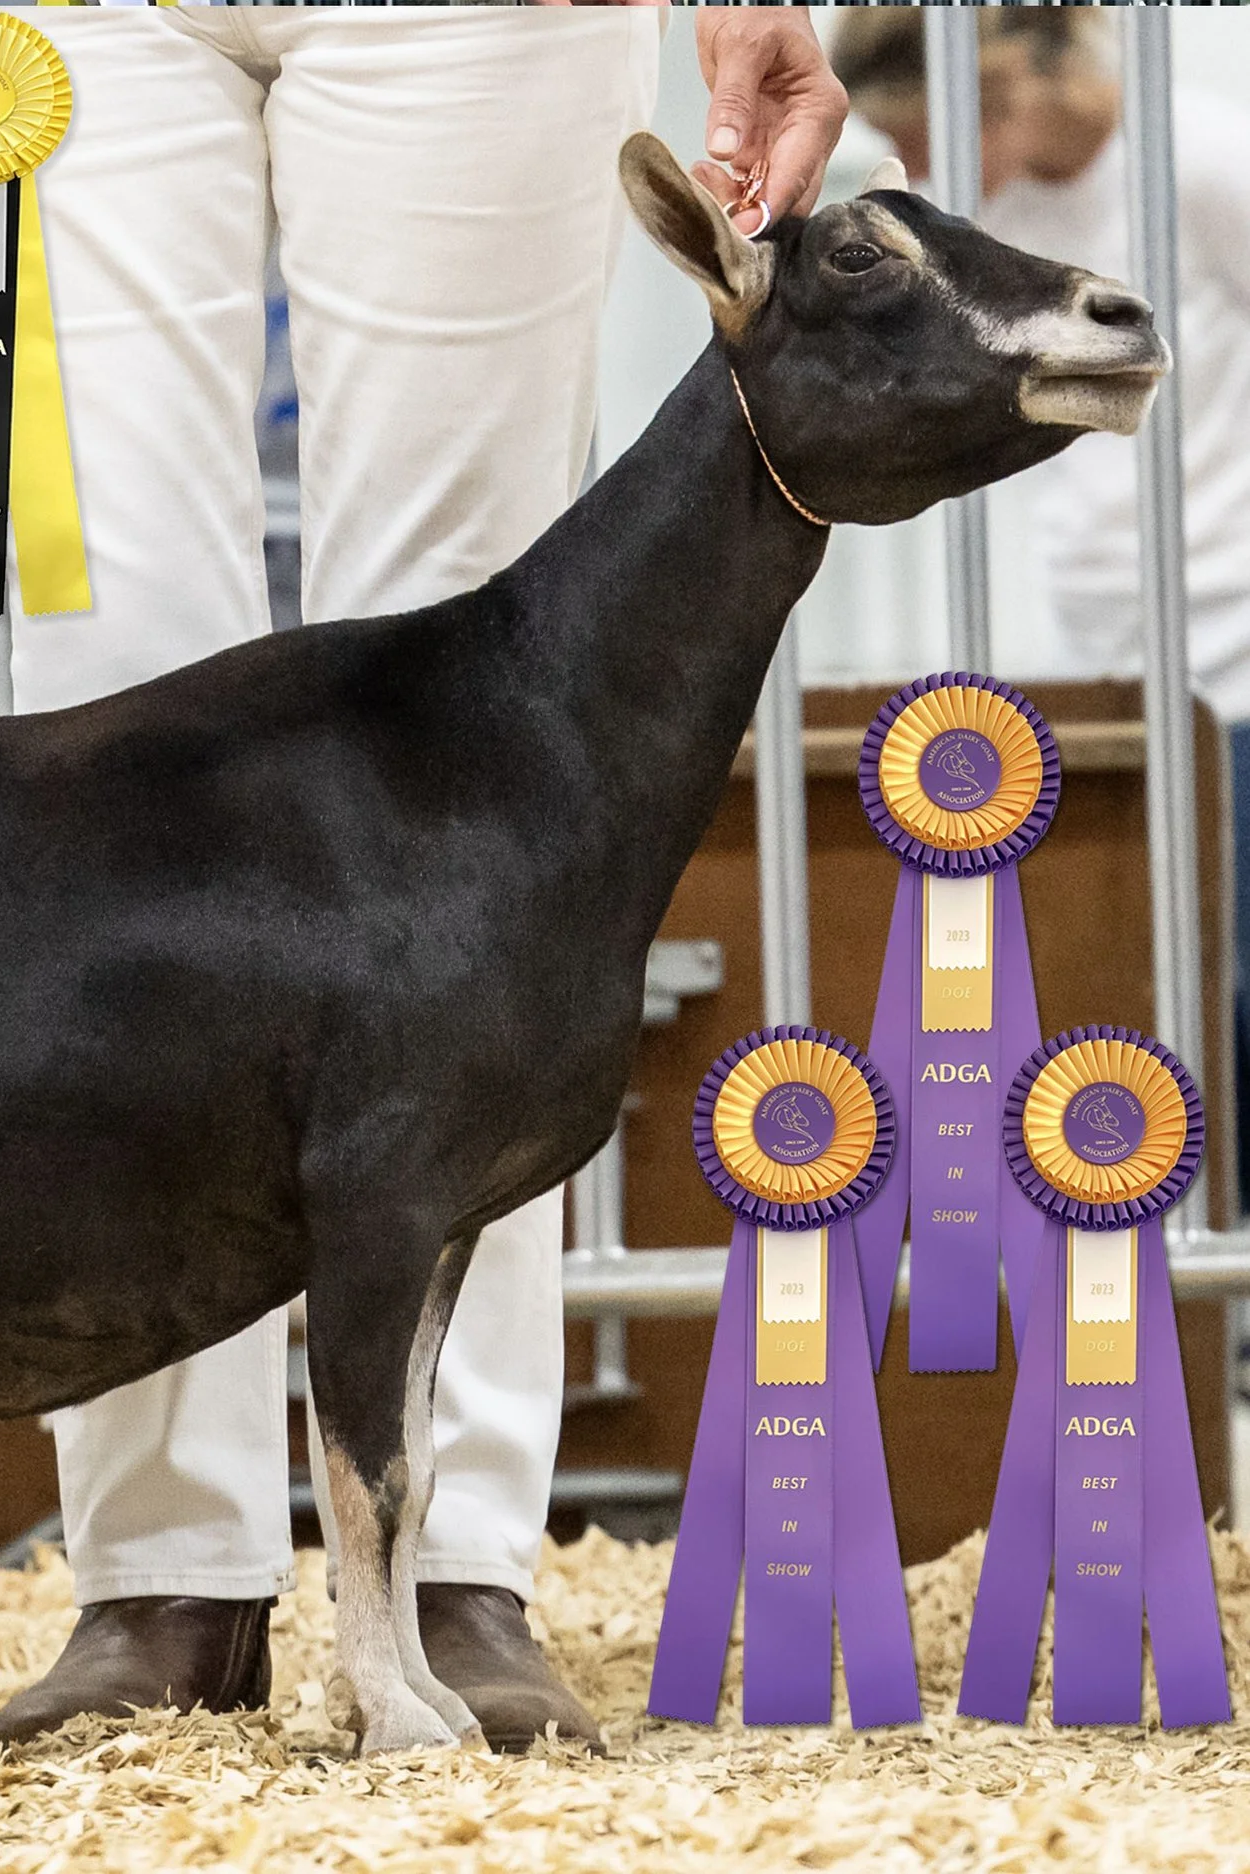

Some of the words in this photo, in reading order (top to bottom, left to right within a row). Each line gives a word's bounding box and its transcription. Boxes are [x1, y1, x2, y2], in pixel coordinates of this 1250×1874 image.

[927, 735, 956, 766] AMERICAN
[957, 733, 980, 744] DAIRY
[980, 743, 996, 763] GOAT
[937, 788, 985, 804] ASSOCIATION
[946, 929, 971, 942] 2023
[921, 1063, 992, 1083] ADGA
[761, 1088, 790, 1119] AMERICAN
[791, 1086, 814, 1097] DAIRY
[814, 1096, 830, 1116] GOAT
[1071, 1088, 1100, 1119] AMERICAN
[1101, 1086, 1124, 1097] DAIRY
[1124, 1096, 1140, 1116] GOAT
[938, 1123, 974, 1136] BEST
[771, 1141, 819, 1157] ASSOCIATION
[1081, 1141, 1129, 1157] ASSOCIATION
[947, 1167, 964, 1179] IN
[932, 1209, 979, 1223] SHOW
[780, 1282, 805, 1295] 2023
[1090, 1282, 1115, 1295] 2023
[755, 1416, 826, 1436] ADGA
[1065, 1416, 1136, 1436] ADGA
[772, 1476, 808, 1489] BEST
[1082, 1476, 1118, 1489] BEST
[781, 1520, 798, 1532] IN
[1091, 1520, 1108, 1532] IN
[766, 1562, 813, 1576] SHOW
[1076, 1562, 1123, 1576] SHOW
